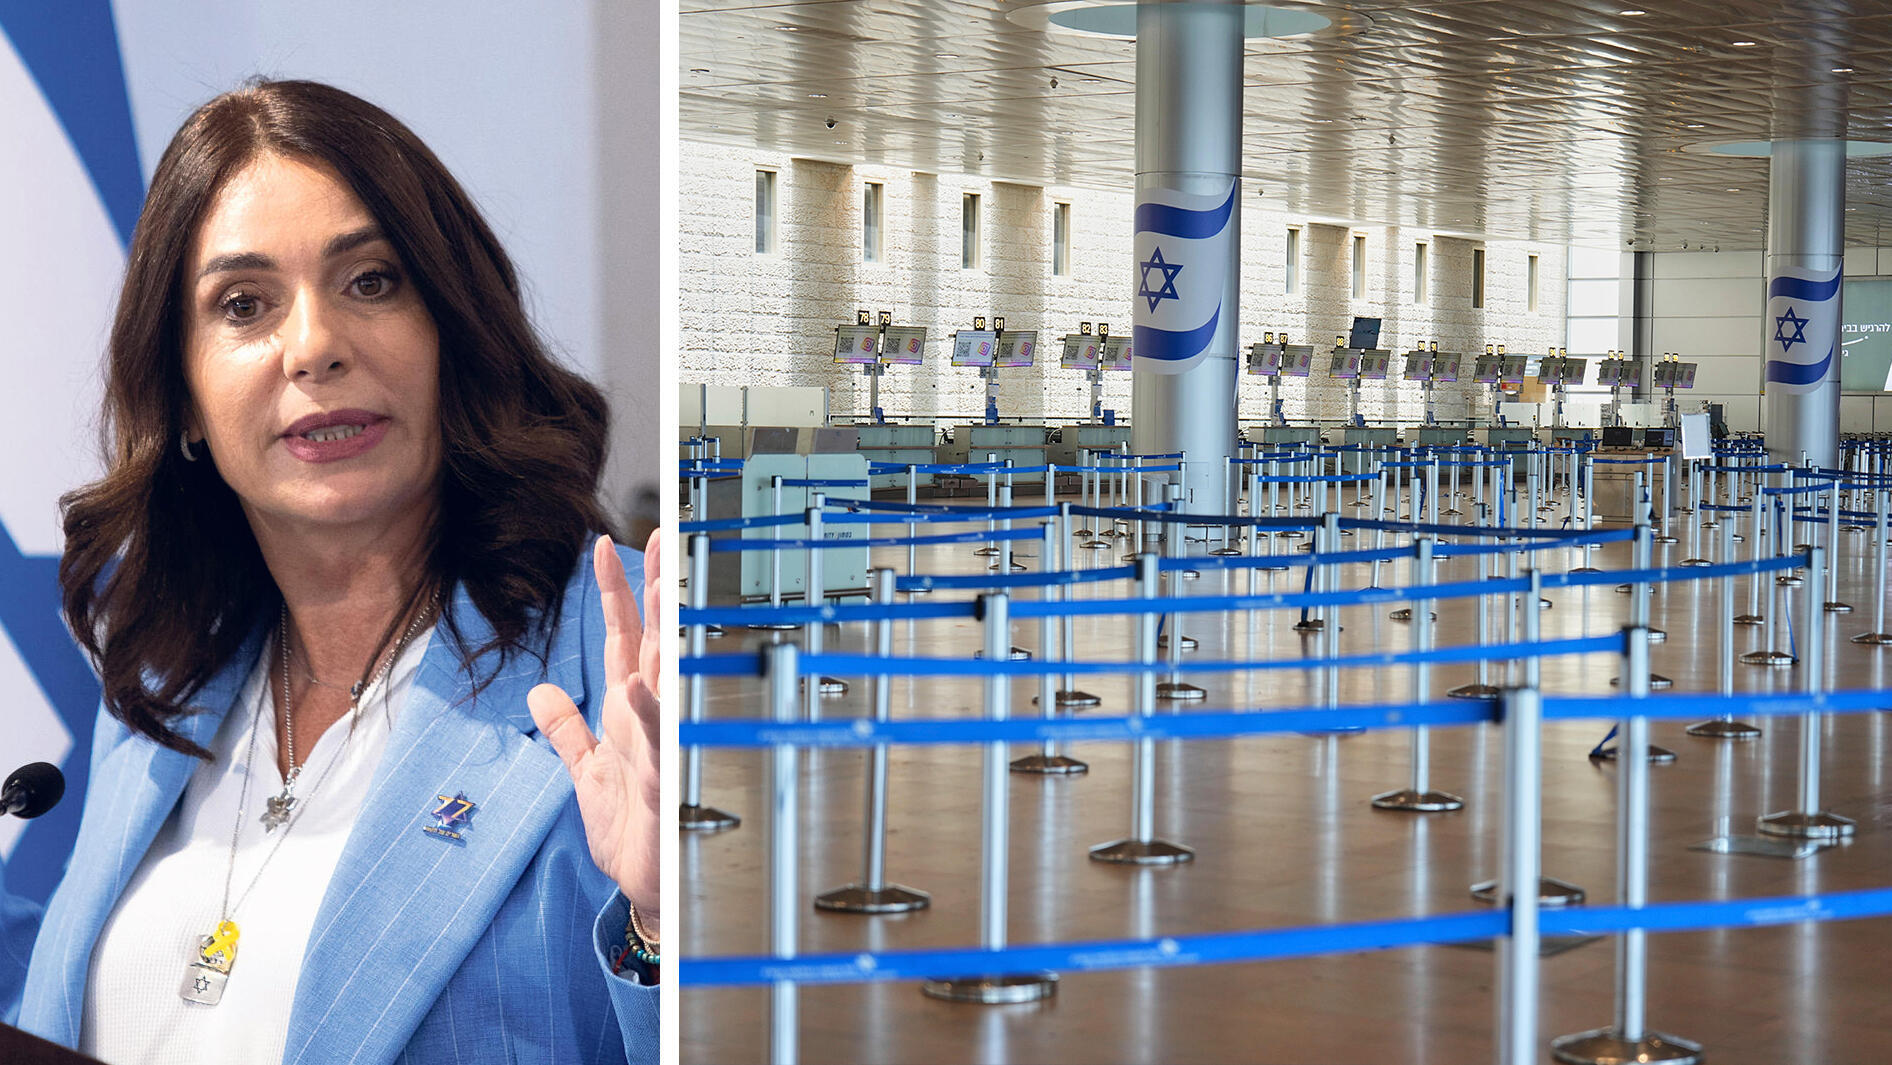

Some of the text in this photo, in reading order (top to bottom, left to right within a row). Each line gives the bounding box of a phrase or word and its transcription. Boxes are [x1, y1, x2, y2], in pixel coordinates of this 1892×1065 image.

[859, 312, 869, 323] 78
[880, 313, 890, 324] 79
[975, 318, 985, 329] 80
[995, 319, 1004, 329] 81
[1082, 323, 1091, 334] 82
[1860, 323, 1891, 332] להרגיש
[1099, 325, 1108, 334] 83
[1336, 337, 1344, 347] 88
[431, 795, 473, 819] 77
